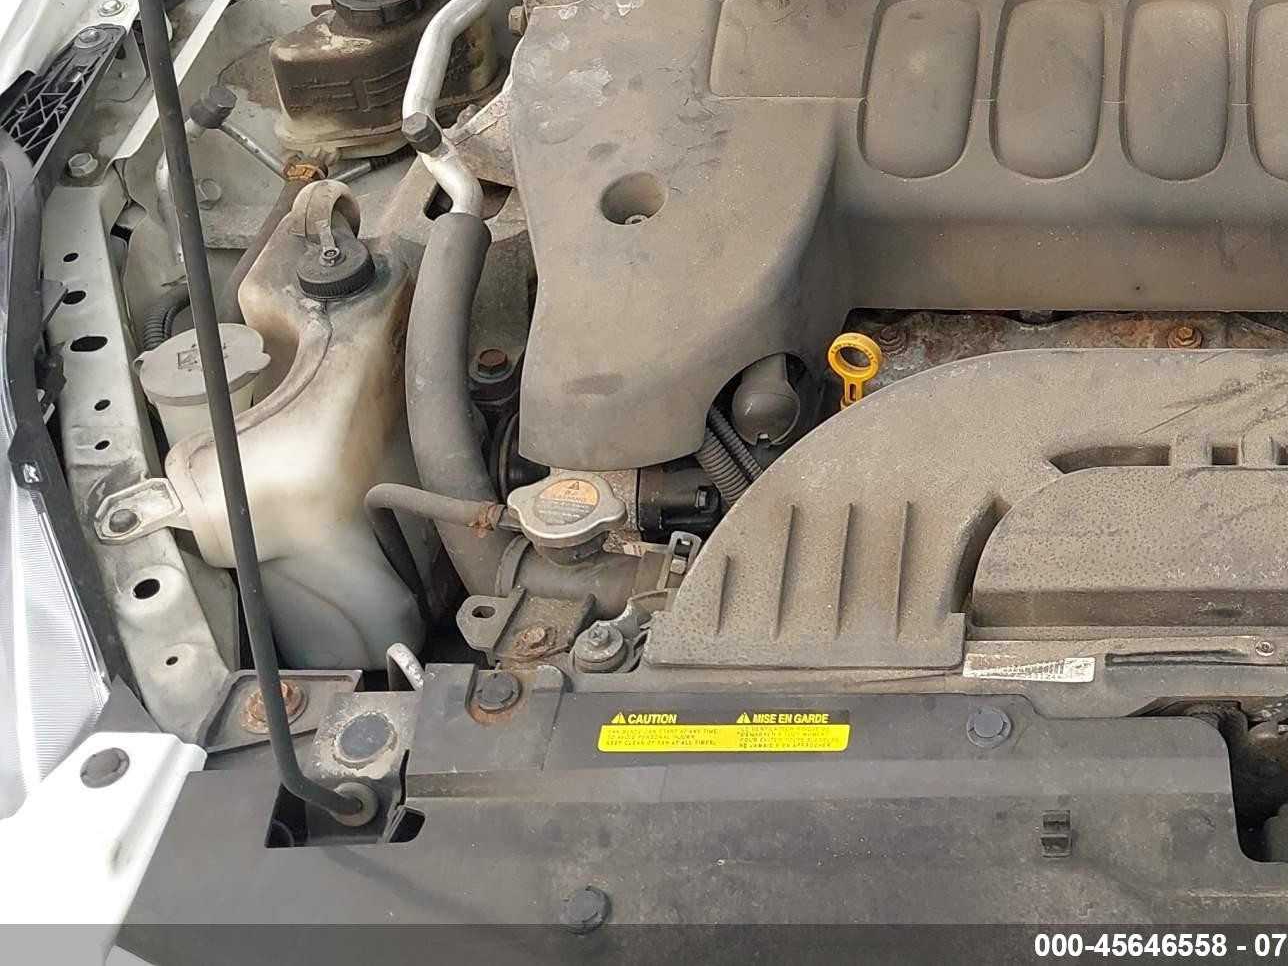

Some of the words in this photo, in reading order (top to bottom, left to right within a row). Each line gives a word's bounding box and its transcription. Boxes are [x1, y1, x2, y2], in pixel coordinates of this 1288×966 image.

[627, 713, 678, 724] CAUTION
[752, 713, 777, 724] MISE
[778, 713, 793, 724] EN
[794, 713, 830, 724] GARDE
